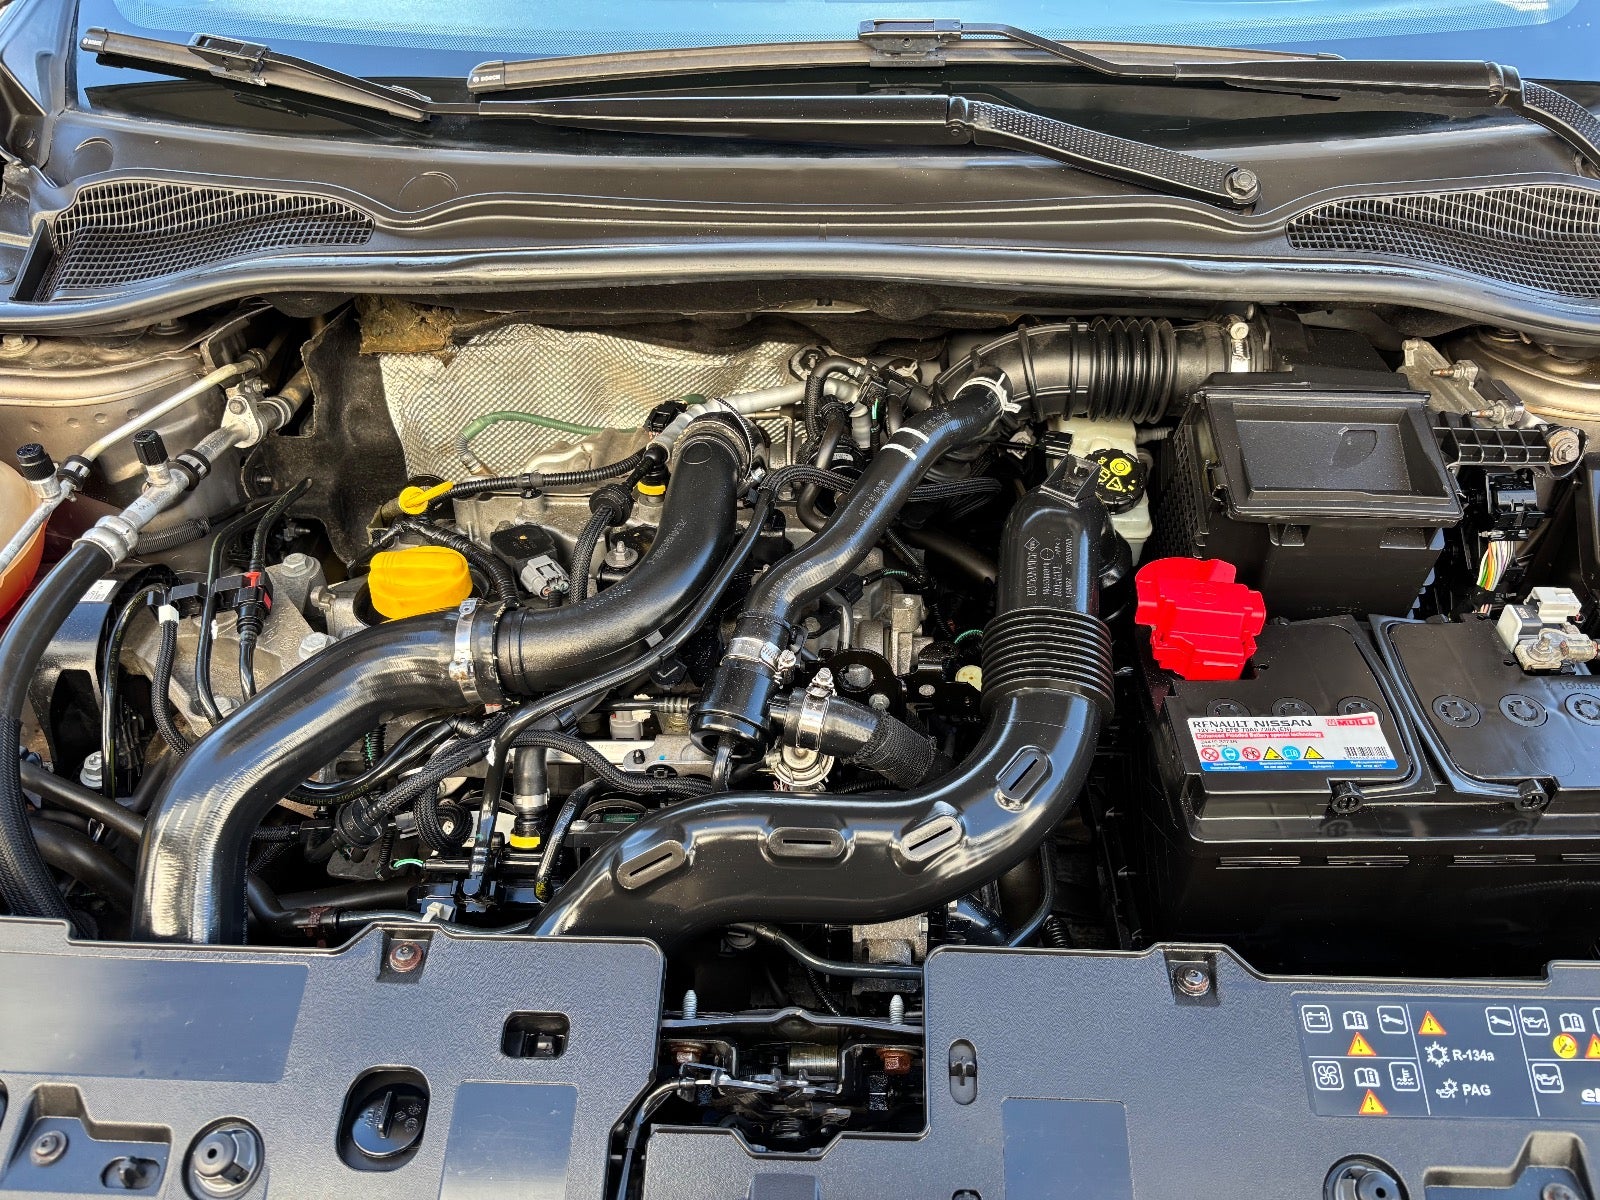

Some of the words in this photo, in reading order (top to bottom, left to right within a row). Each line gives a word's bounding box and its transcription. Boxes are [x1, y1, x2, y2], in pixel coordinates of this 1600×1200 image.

[1192, 719, 1249, 728] RENAULT
[1254, 719, 1313, 728] NISSAN
[1453, 1049, 1495, 1062] R-134a
[1463, 1084, 1491, 1096] PAG
